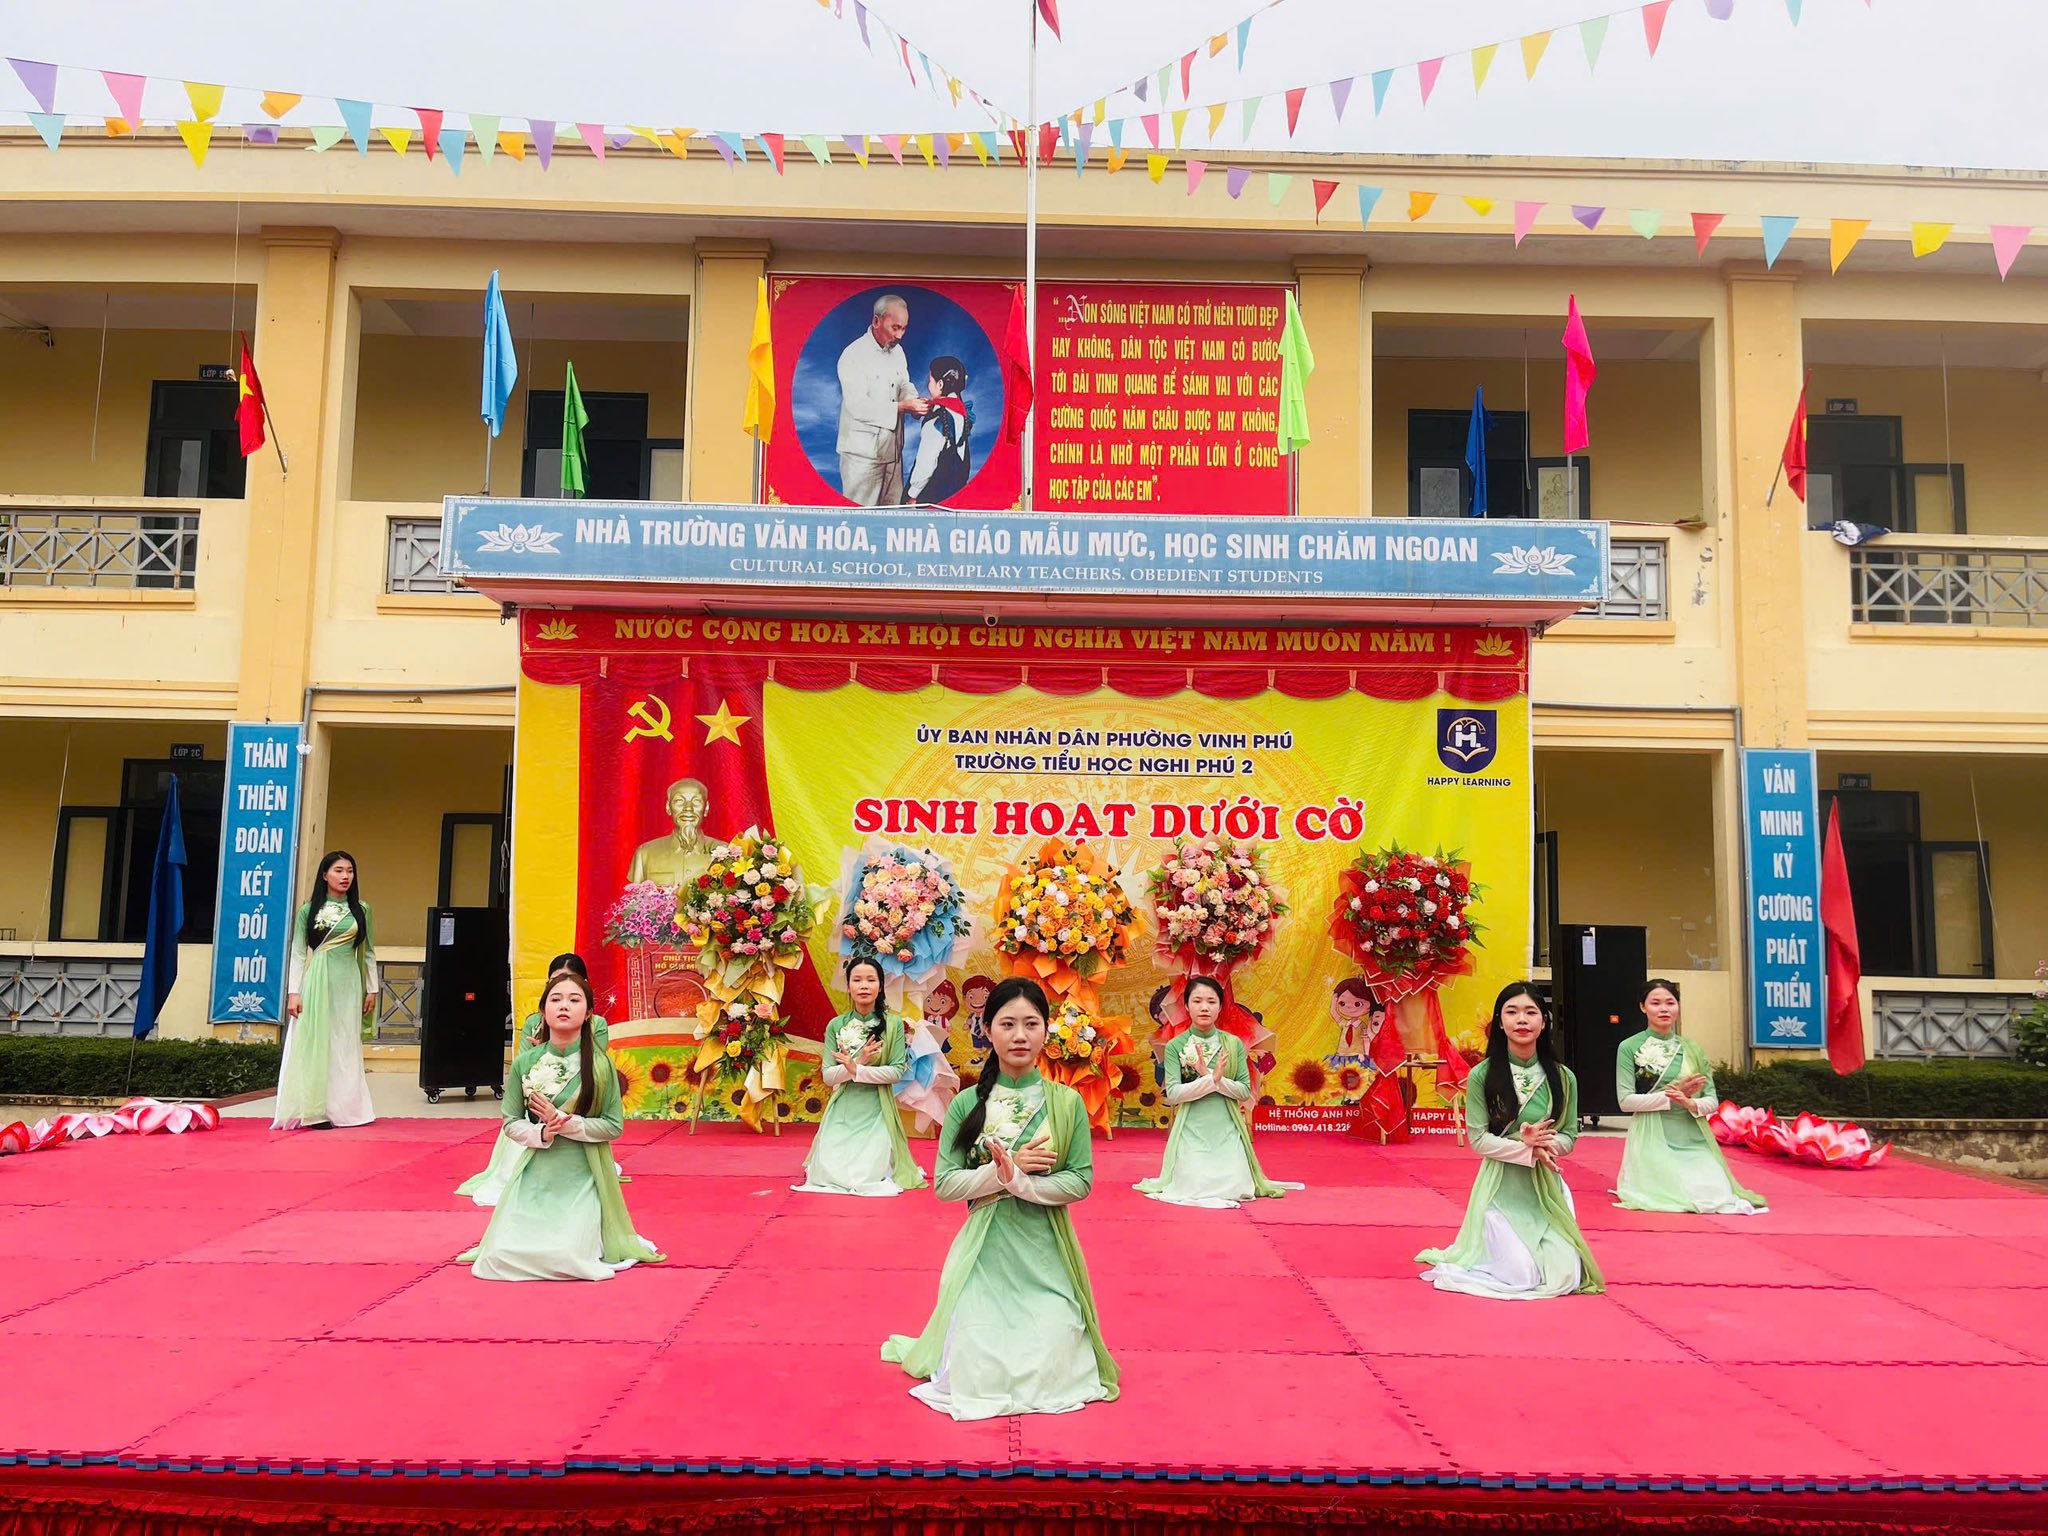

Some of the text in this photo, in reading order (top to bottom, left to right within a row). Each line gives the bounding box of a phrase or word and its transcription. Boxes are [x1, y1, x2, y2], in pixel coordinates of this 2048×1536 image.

[1100, 300, 1127, 324] SÔNG
[1129, 300, 1150, 329] VIỆT
[1152, 305, 1174, 325] NAM
[1177, 301, 1190, 325] CÓ
[1193, 298, 1212, 326] TRỞ
[1214, 301, 1233, 326] NÊN
[1236, 305, 1257, 326] TƯƠI
[1259, 307, 1279, 331] ĐẸP
[1052, 334, 1279, 365] HAY KHÔNG, DÂN TỘC VIỆT NAM CÓ BƯỚC
[1051, 366, 1279, 397] TỚI ĐÀI VINH QUANG ĐỂ SÁNH VAI VỚI CÁC
[1051, 402, 1278, 436] CƯỜNG QUỐC NĂM CHÂU ĐƯỢC HAY KHÔNG,
[1050, 437, 1279, 470] CHÍNH LÀ NHỜ MỘT PHẦN LỚN Ở CÔNG
[1049, 478, 1069, 504] HỌC
[1071, 475, 1090, 504] TẬP
[1092, 472, 1112, 500] CỦA
[1114, 476, 1134, 500] CÁC
[575, 514, 1478, 563] NHÀ TRƯỜNG VĂN HÓA, NHÀ GIÁO MẪU MỰC, HỌC SINH CHĂM NGOAN
[730, 557, 827, 574] CULTURAL
[832, 561, 912, 578] SCHOOL,
[917, 563, 1023, 579] EXEMPLARY
[1131, 568, 1223, 583] OBEDIENT
[1227, 569, 1323, 584] STUDENTS
[615, 615, 693, 639] NƯỚC
[702, 617, 782, 645] CỘNG
[908, 623, 960, 650] HỘI
[1131, 627, 1195, 654] VIỆT
[1203, 631, 1267, 651] NAM
[1276, 628, 1361, 652] MUÔN
[1370, 629, 1434, 652] NĂM
[917, 723, 1292, 749] ỦY BAN NHÂN DÂN PHƯỜNG VINH PHÚ
[243, 737, 288, 768] THÂN
[955, 750, 1253, 775] TRƯỜNG TIỂU HỌC NGHI PHÚ 2
[1427, 777, 1511, 787] HAPPY LEARNING
[1763, 763, 1796, 794] VĂN
[238, 780, 288, 816] THIỆN
[854, 796, 1364, 846] SINH HOẠT DƯỚI CỜ
[1760, 811, 1803, 836] MINH
[235, 822, 283, 853] ĐOÀN
[1773, 842, 1793, 878] KỶ
[240, 861, 272, 896] KẾT
[238, 903, 268, 940] ĐỔI
[1758, 893, 1813, 921] CƯƠNG
[1766, 933, 1807, 964] PHÁT
[233, 949, 266, 983] MỚI
[1764, 971, 1811, 1008] TRIỂN
[1255, 1122, 1289, 1132] Hotline:
[1269, 1108, 1281, 1120] HỆ
[1284, 1107, 1319, 1119] THỐNG
[1322, 1110, 1343, 1119] ANH
[1413, 1112, 1445, 1121] HAPPY
